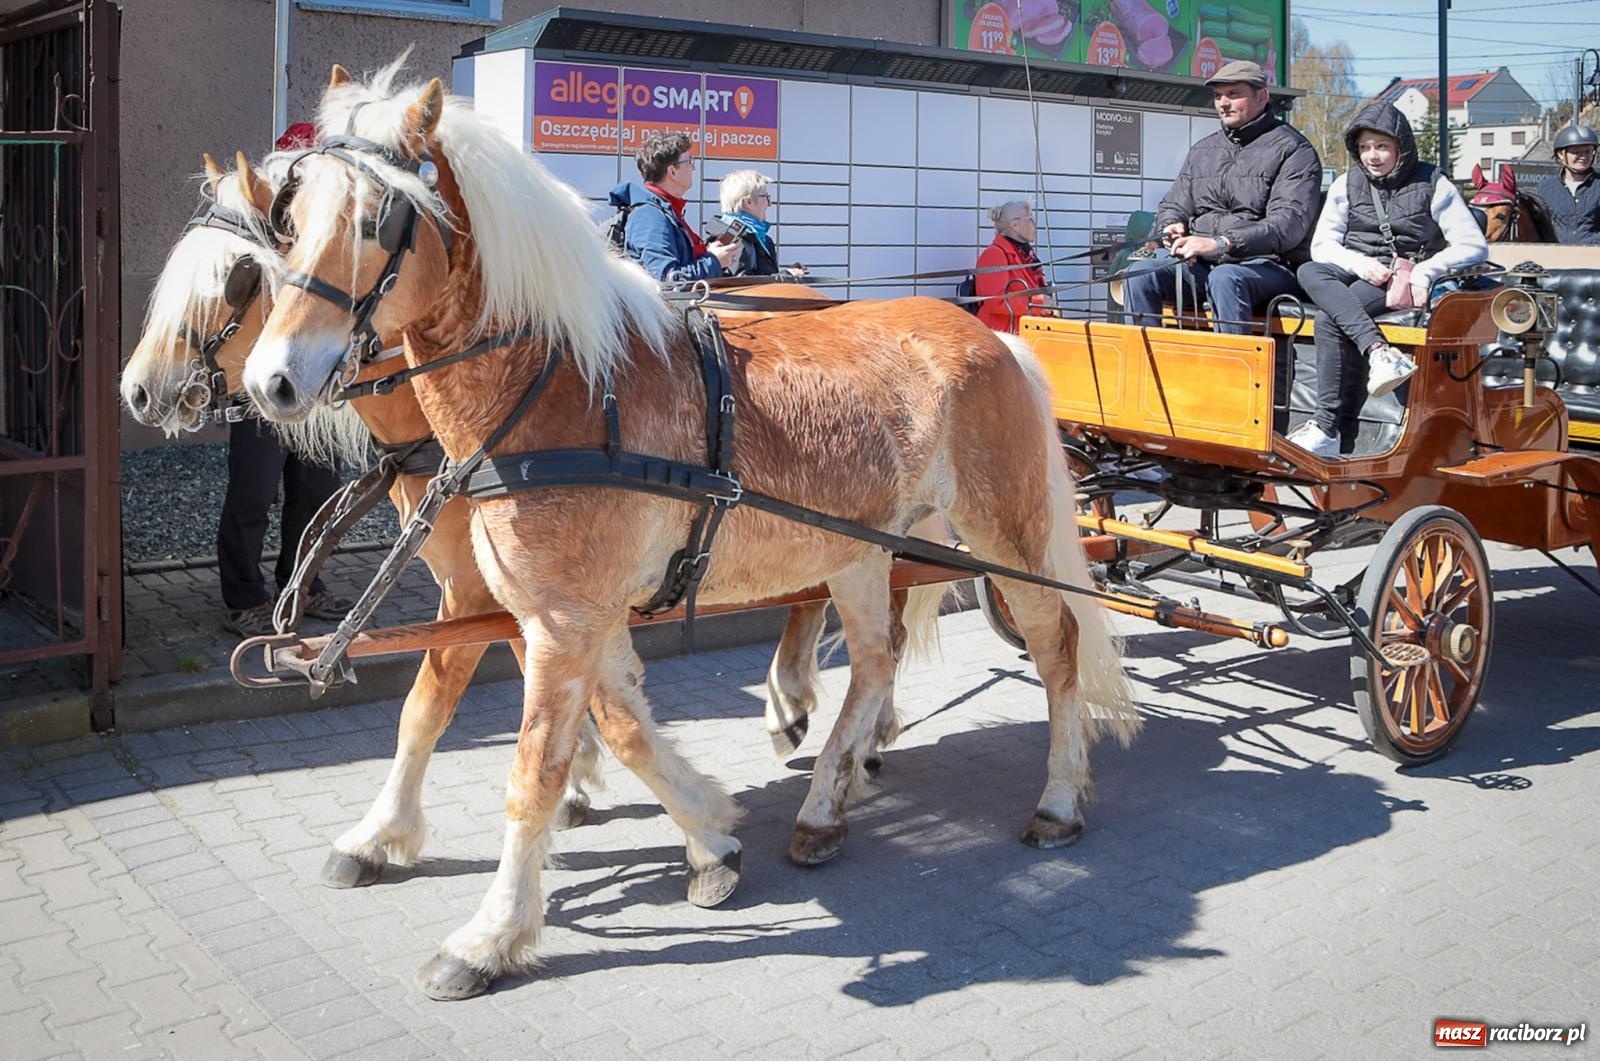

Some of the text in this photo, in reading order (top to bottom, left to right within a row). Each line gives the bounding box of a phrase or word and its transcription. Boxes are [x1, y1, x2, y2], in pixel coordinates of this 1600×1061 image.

[550, 70, 651, 114] allegro
[540, 119, 636, 143] Oszczędzaj
[720, 131, 772, 147] paczce
